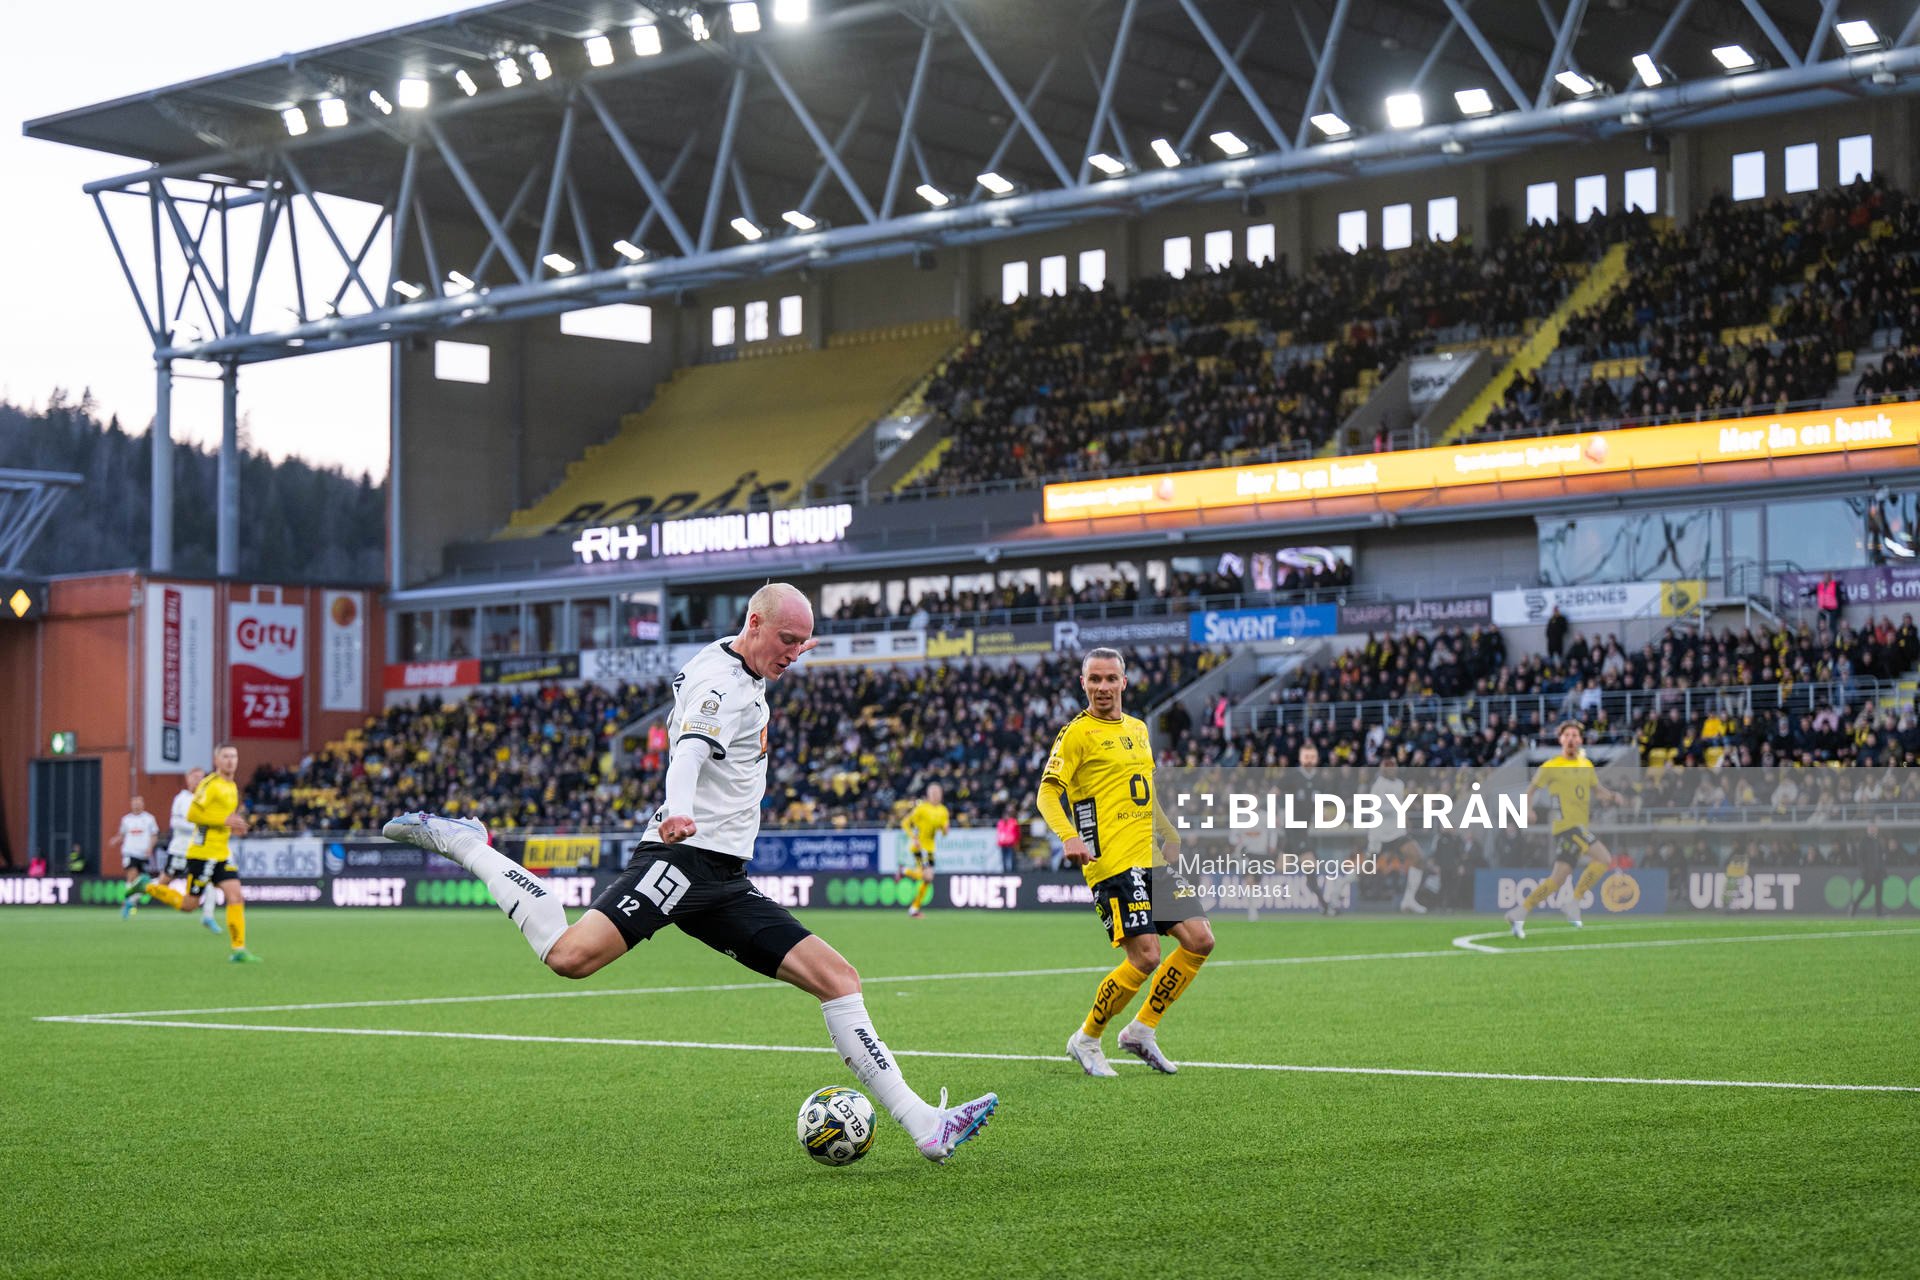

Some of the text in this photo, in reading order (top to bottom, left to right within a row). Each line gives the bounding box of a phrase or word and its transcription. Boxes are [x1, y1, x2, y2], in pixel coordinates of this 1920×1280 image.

[1801, 423, 1831, 445] en
[1836, 413, 1892, 443] bank
[237, 617, 297, 650] City
[1204, 610, 1278, 643] SILVENT
[504, 869, 547, 898] MAXXIS
[616, 895, 640, 917] 12
[1130, 910, 1148, 927] 23
[854, 1028, 890, 1071] MAXXIS
[858, 1054, 879, 1080] TYRES
[833, 1099, 866, 1138] SELECT
